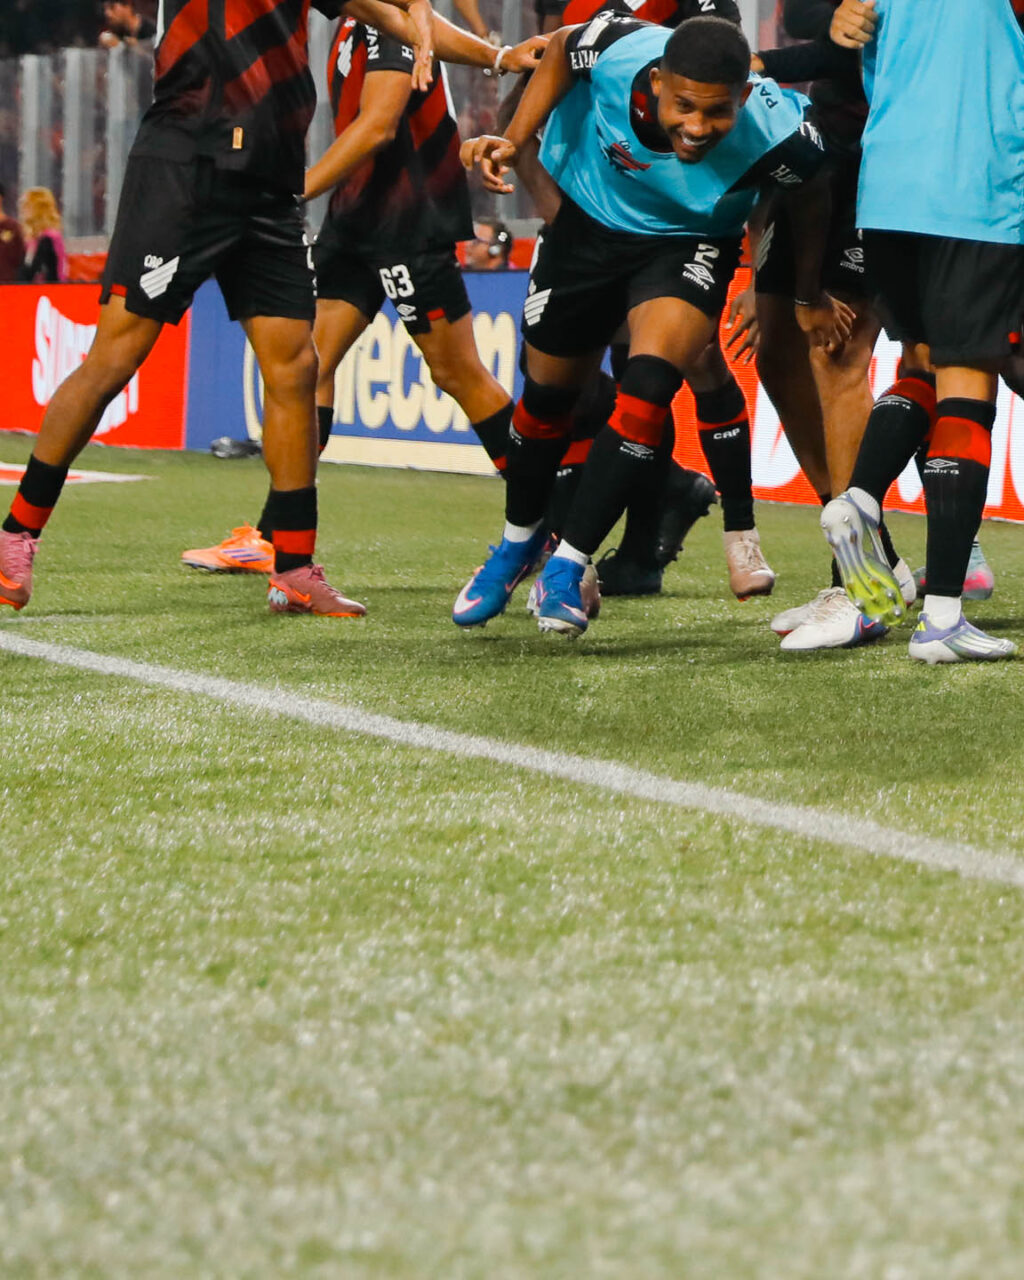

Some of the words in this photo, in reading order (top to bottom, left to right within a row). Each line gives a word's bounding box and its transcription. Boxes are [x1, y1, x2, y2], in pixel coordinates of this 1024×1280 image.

[379, 264, 415, 299] 63
[682, 271, 710, 291] umbro
[713, 427, 741, 440] CAP
